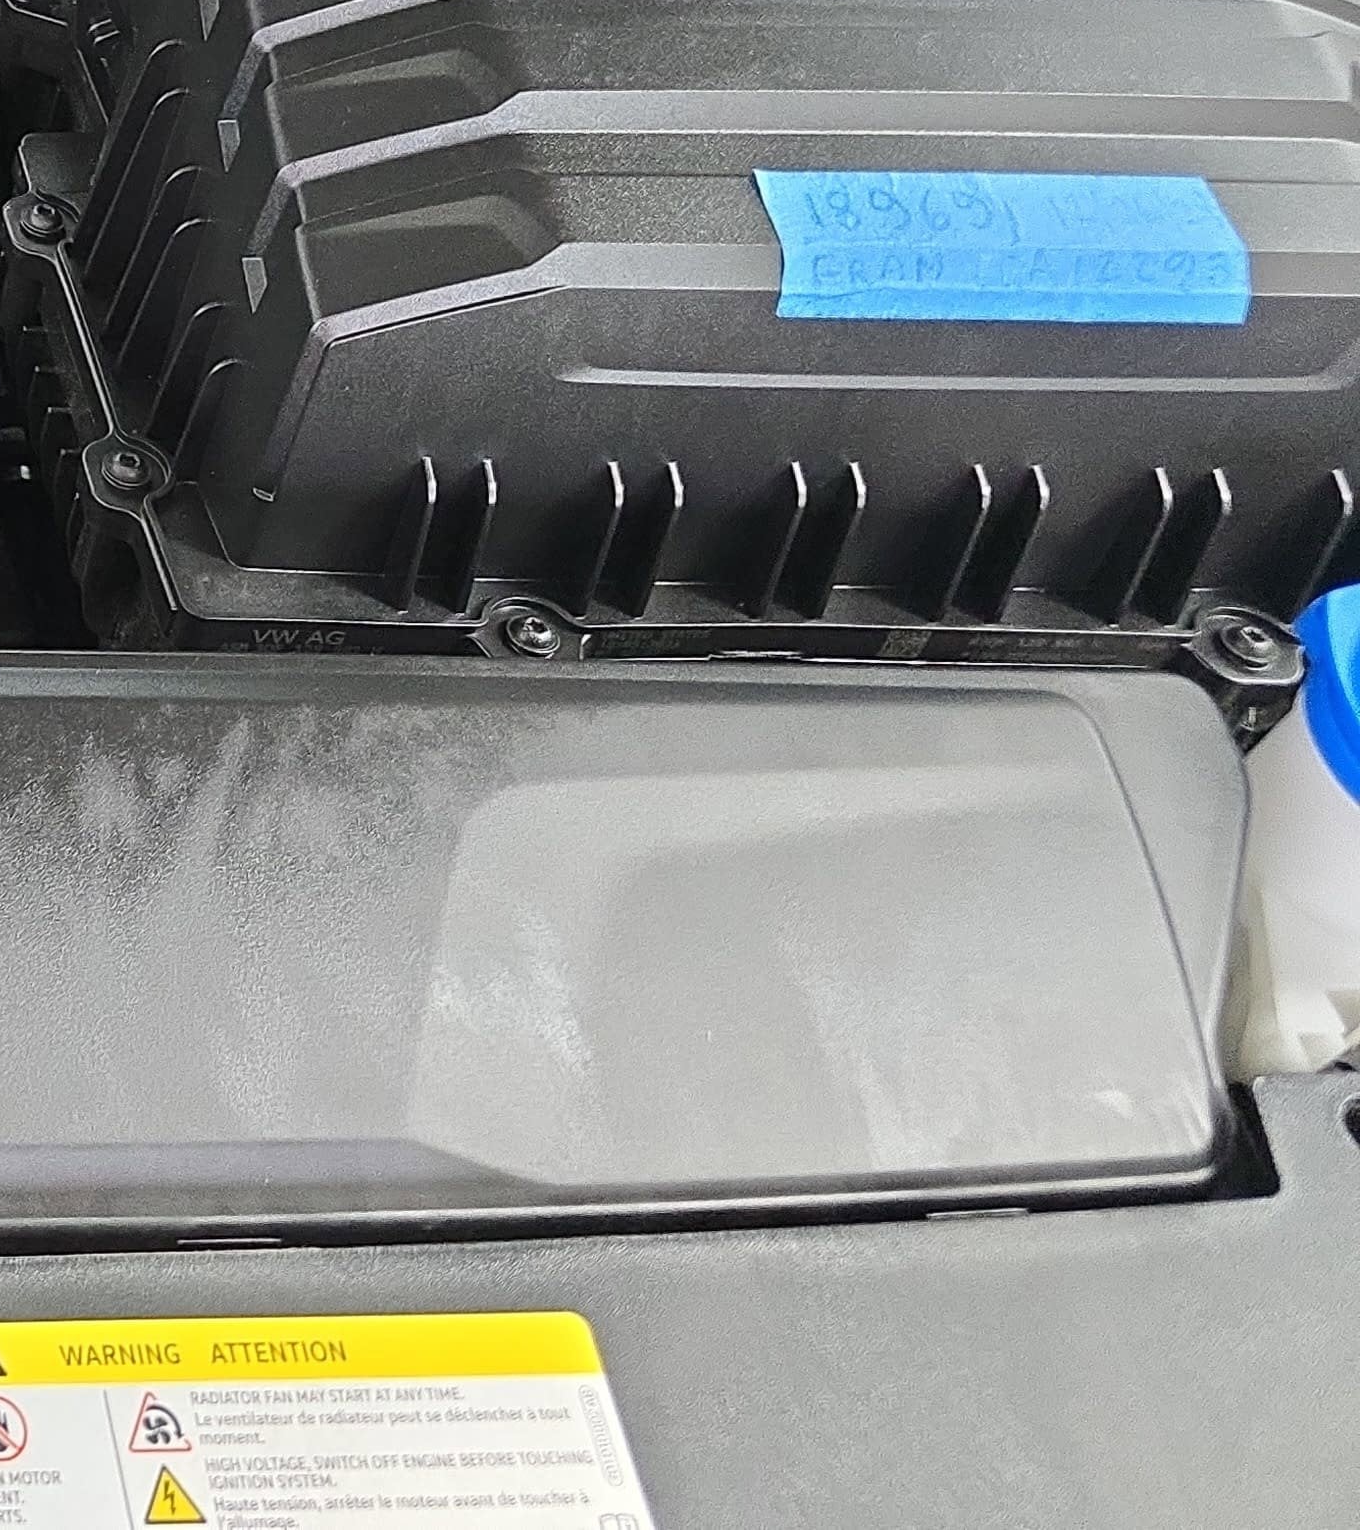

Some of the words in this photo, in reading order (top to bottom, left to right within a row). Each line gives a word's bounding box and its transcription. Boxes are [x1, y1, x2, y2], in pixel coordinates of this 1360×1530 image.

[252, 628, 302, 645] VW
[305, 630, 346, 646] AG
[59, 1342, 182, 1367] WARNING
[210, 1339, 348, 1365] ATTENTION
[190, 1390, 261, 1406] RADIATOR
[264, 1390, 293, 1405] FAN
[296, 1389, 326, 1404] MAY
[329, 1388, 372, 1404] START
[375, 1387, 392, 1402] AT
[394, 1387, 425, 1402] ANY
[425, 1386, 466, 1401] TIME.
[194, 1412, 212, 1426] Le
[216, 1410, 294, 1426] ventilateur
[297, 1410, 316, 1425] de
[320, 1409, 384, 1424] radiateur
[389, 1410, 424, 1427] peut
[426, 1411, 443, 1422] se
[445, 1406, 523, 1422] déclencher
[525, 1406, 537, 1421] à
[539, 1407, 571, 1421] tout
[199, 1432, 265, 1446] moment.
[205, 1457, 241, 1472] HIGH
[244, 1456, 312, 1473] VOLTAGE,
[315, 1454, 369, 1470] SWITCH
[372, 1453, 399, 1469] OFF
[403, 1452, 457, 1468] ENGINE
[460, 1451, 515, 1467] BEFORE
[518, 1449, 594, 1466] TOUCHING
[7, 1470, 62, 1486] MOTOR
[209, 1474, 273, 1490] IGNITION
[277, 1473, 337, 1489] SYSTEM.
[214, 1496, 258, 1512] Haute
[262, 1496, 322, 1513] tension,
[325, 1495, 375, 1510] arrêter
[378, 1492, 391, 1508] le
[395, 1493, 449, 1508] moteur
[454, 1493, 493, 1507] avant
[497, 1491, 516, 1506] de
[520, 1489, 576, 1506] toucher
[578, 1489, 590, 1505] à
